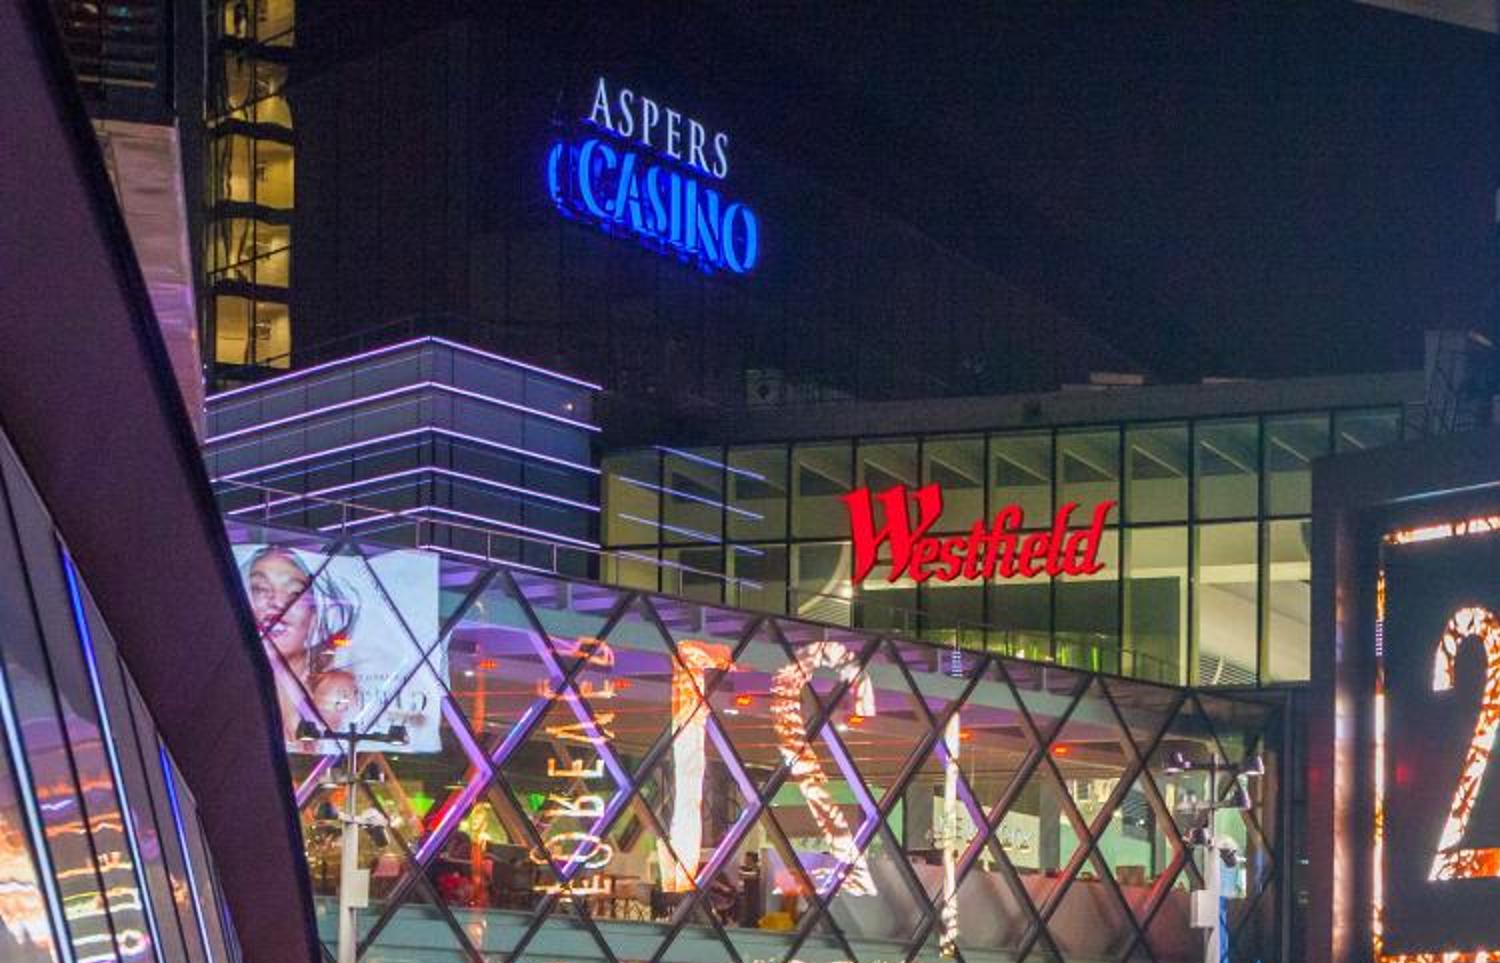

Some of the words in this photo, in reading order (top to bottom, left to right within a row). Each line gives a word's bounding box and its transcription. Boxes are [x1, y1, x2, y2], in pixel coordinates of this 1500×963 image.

[590, 76, 729, 179] ASPERS
[578, 139, 759, 273] CASINO
[838, 483, 1119, 586] Westfield
